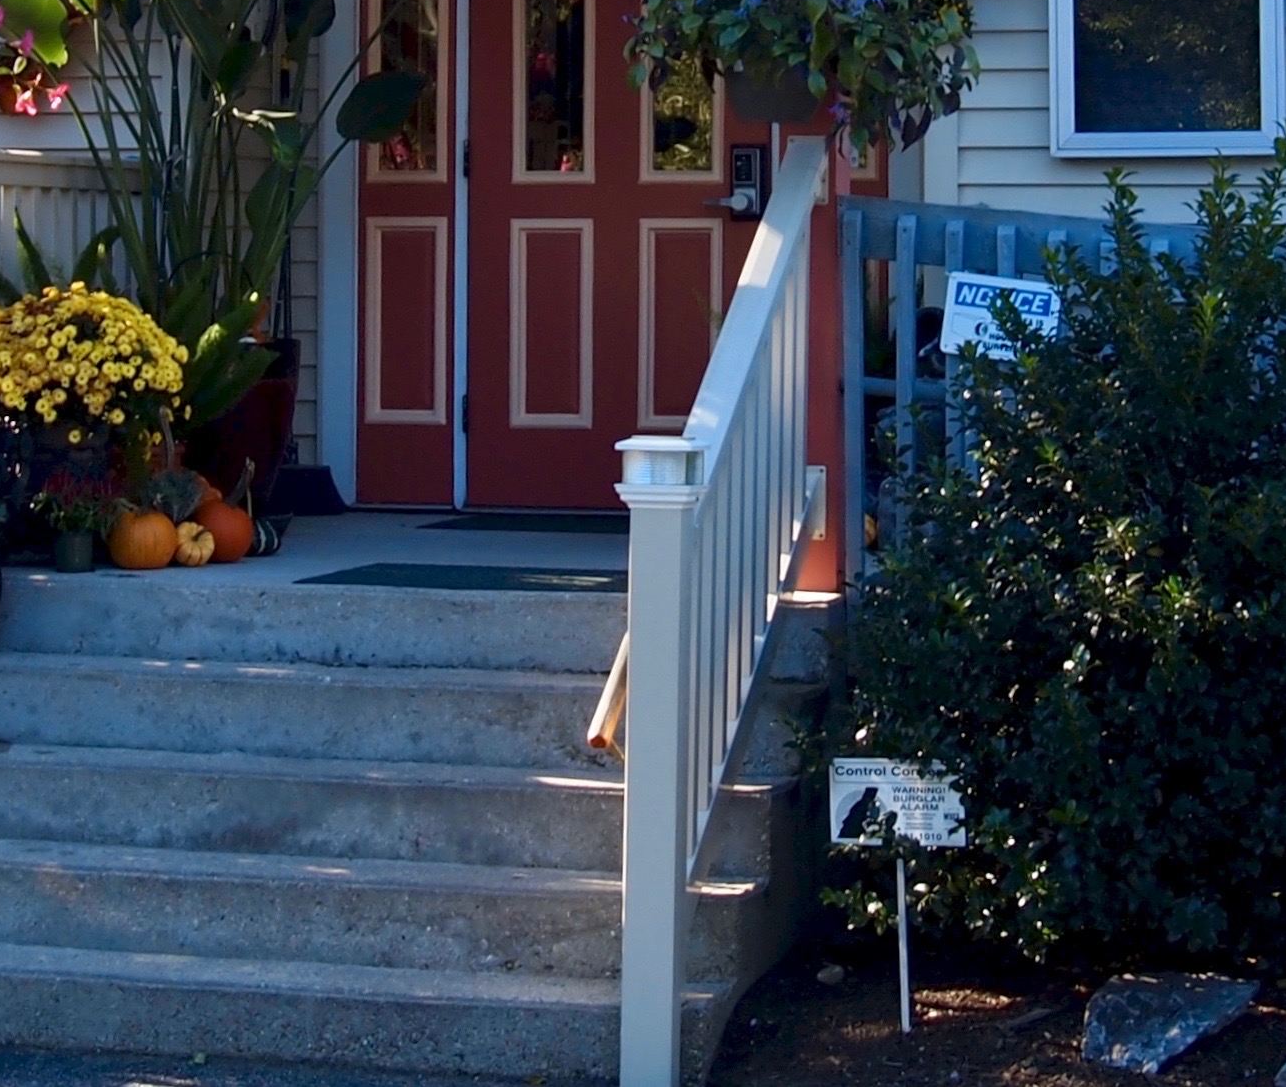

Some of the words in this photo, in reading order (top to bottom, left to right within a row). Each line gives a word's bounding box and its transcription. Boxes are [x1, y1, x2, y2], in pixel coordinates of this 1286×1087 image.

[957, 284, 1049, 313] NOICE
[835, 765, 886, 776] Control
[893, 795, 945, 803] BURGLAR
[899, 803, 939, 811] ALARM
